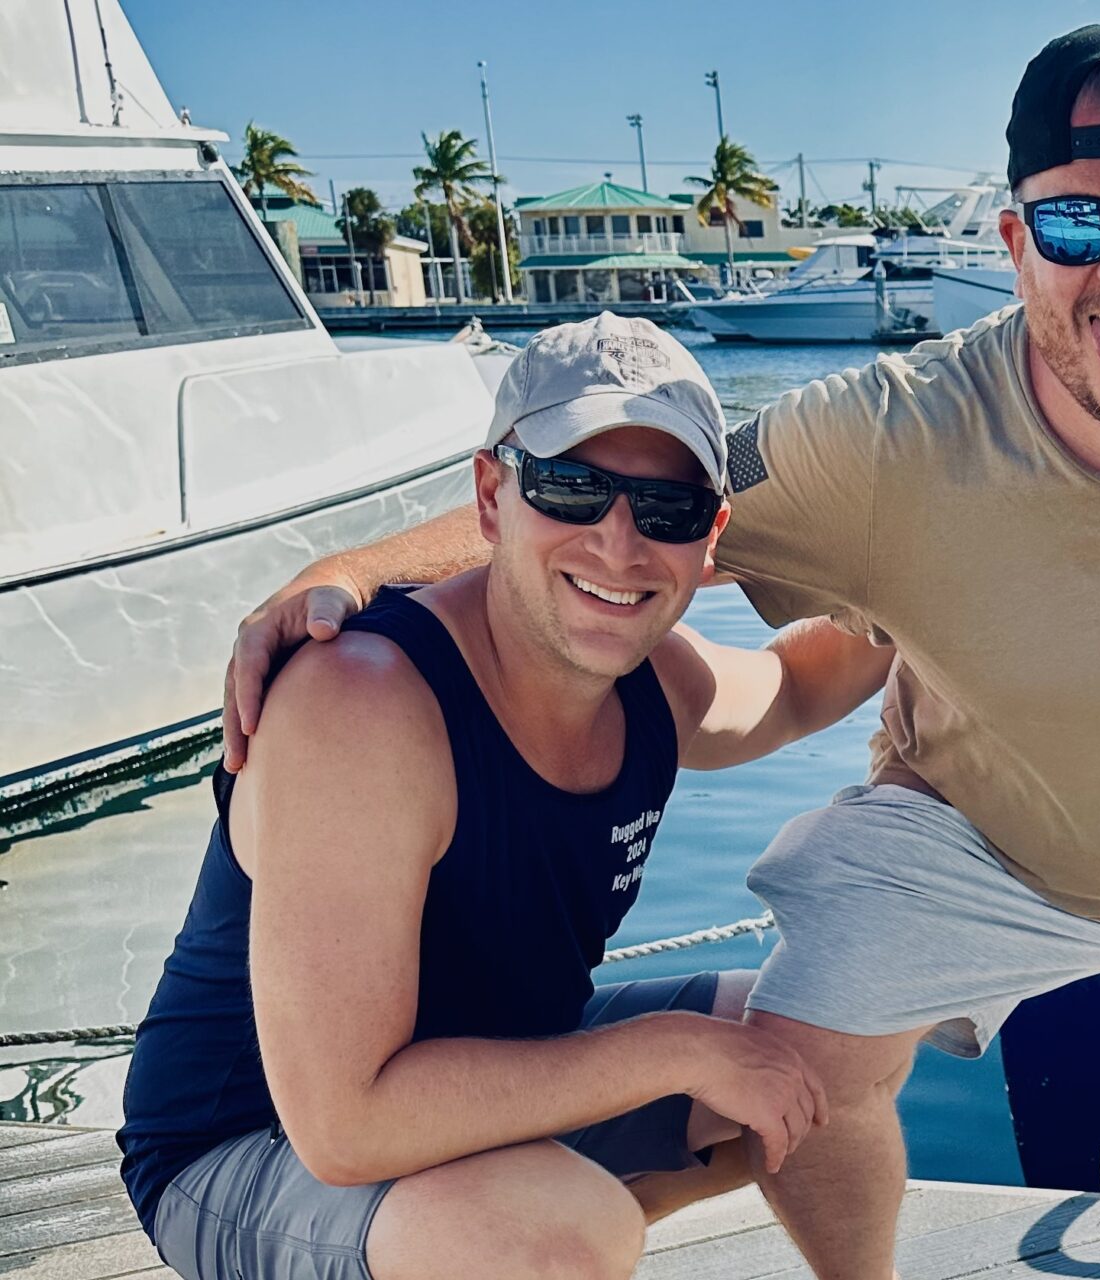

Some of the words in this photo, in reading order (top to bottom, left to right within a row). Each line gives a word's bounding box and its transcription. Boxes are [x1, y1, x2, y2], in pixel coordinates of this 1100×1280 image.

[611, 811, 645, 844] Rugged
[626, 837, 647, 863] 2024
[611, 873, 632, 892] Key
